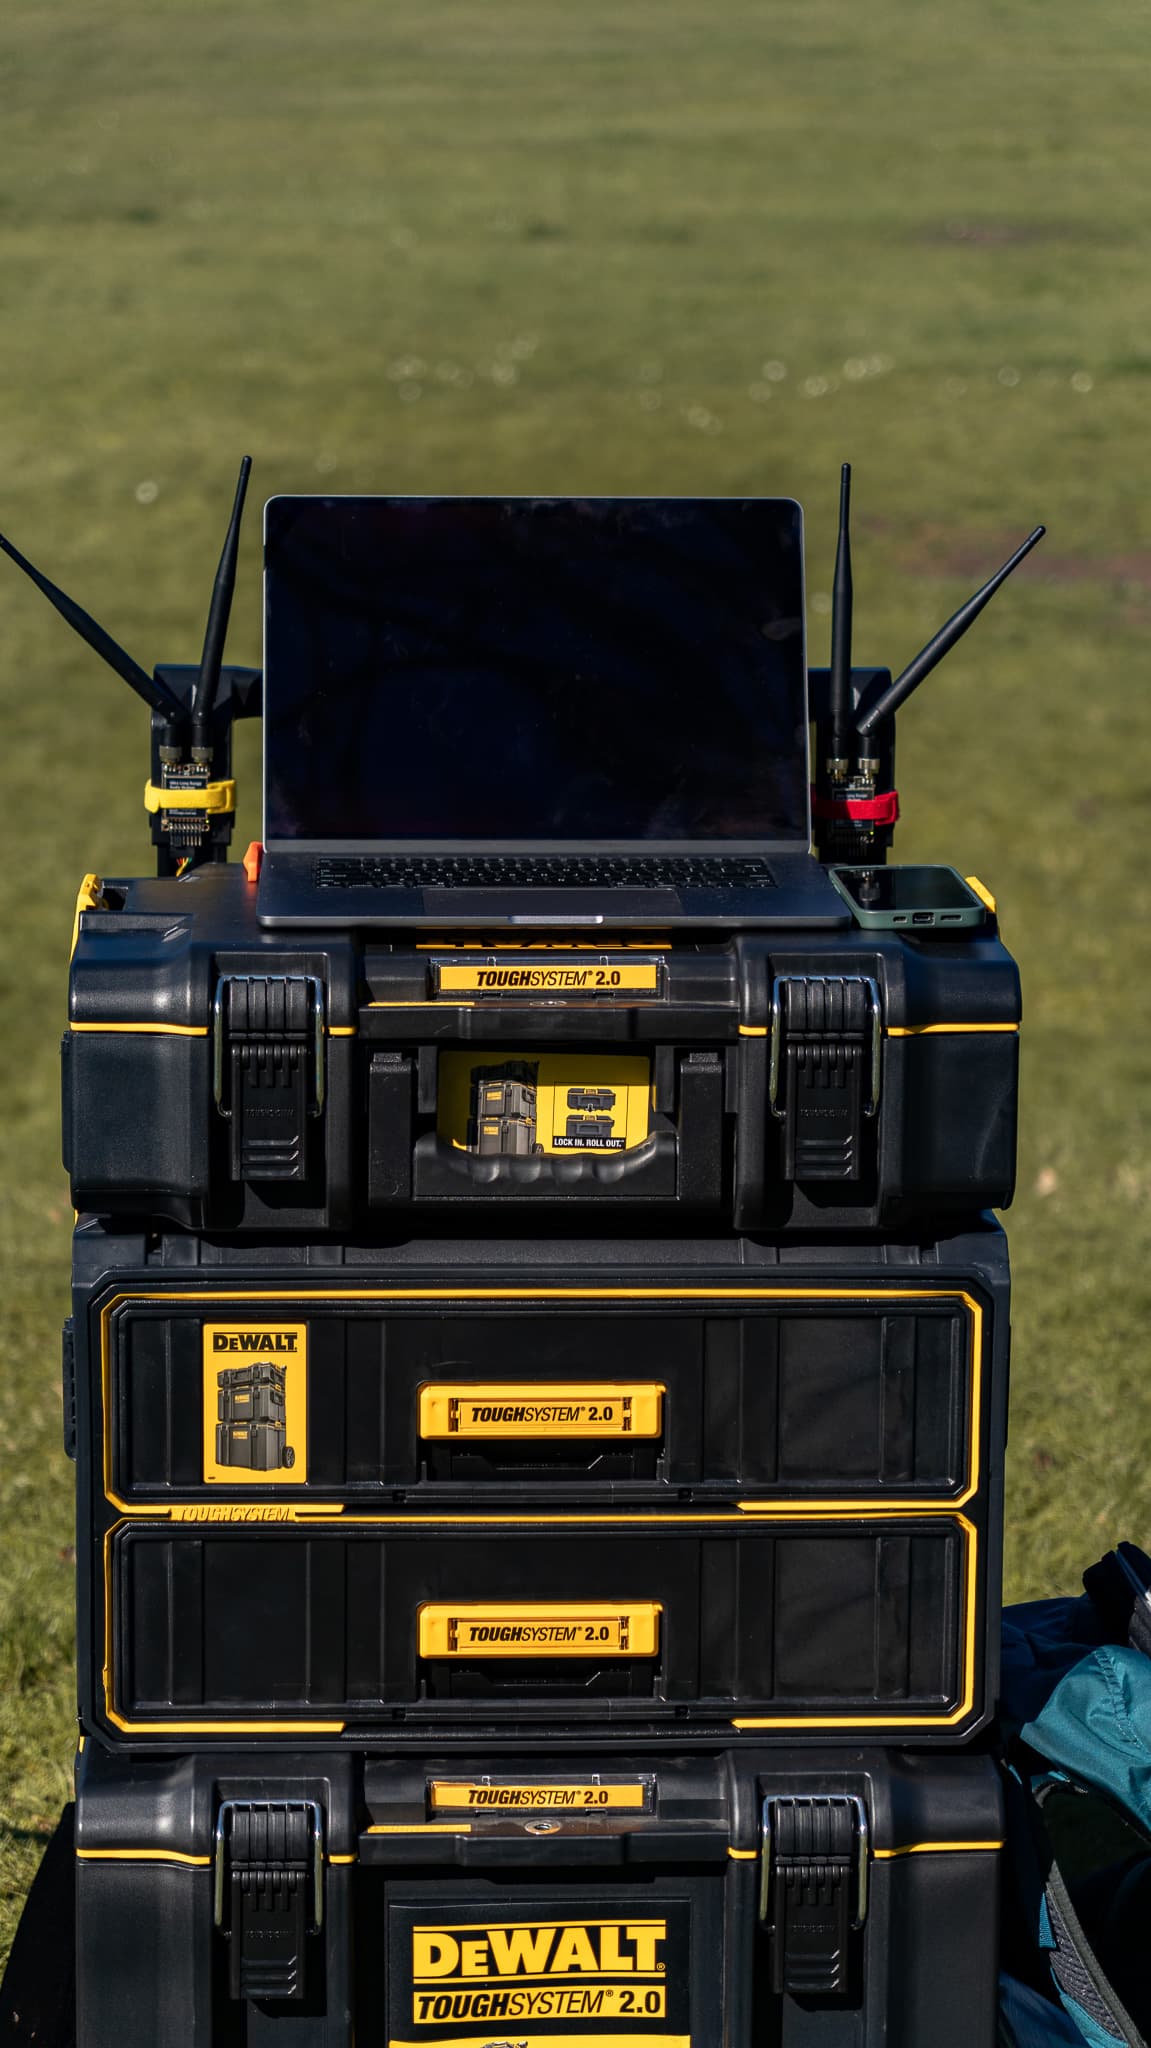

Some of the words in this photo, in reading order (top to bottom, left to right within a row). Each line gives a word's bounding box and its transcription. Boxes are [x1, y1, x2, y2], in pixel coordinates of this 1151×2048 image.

[595, 971, 621, 986] 2.0
[554, 1138, 573, 1146] LOCK
[586, 1139, 604, 1147] ROLL
[588, 1406, 613, 1421] 2.0
[178, 1506, 290, 1522] TOUGHSYSTEM
[585, 1626, 610, 1641] 2.0
[583, 1790, 609, 1804] 2.0
[619, 1990, 660, 2014] 2.0
